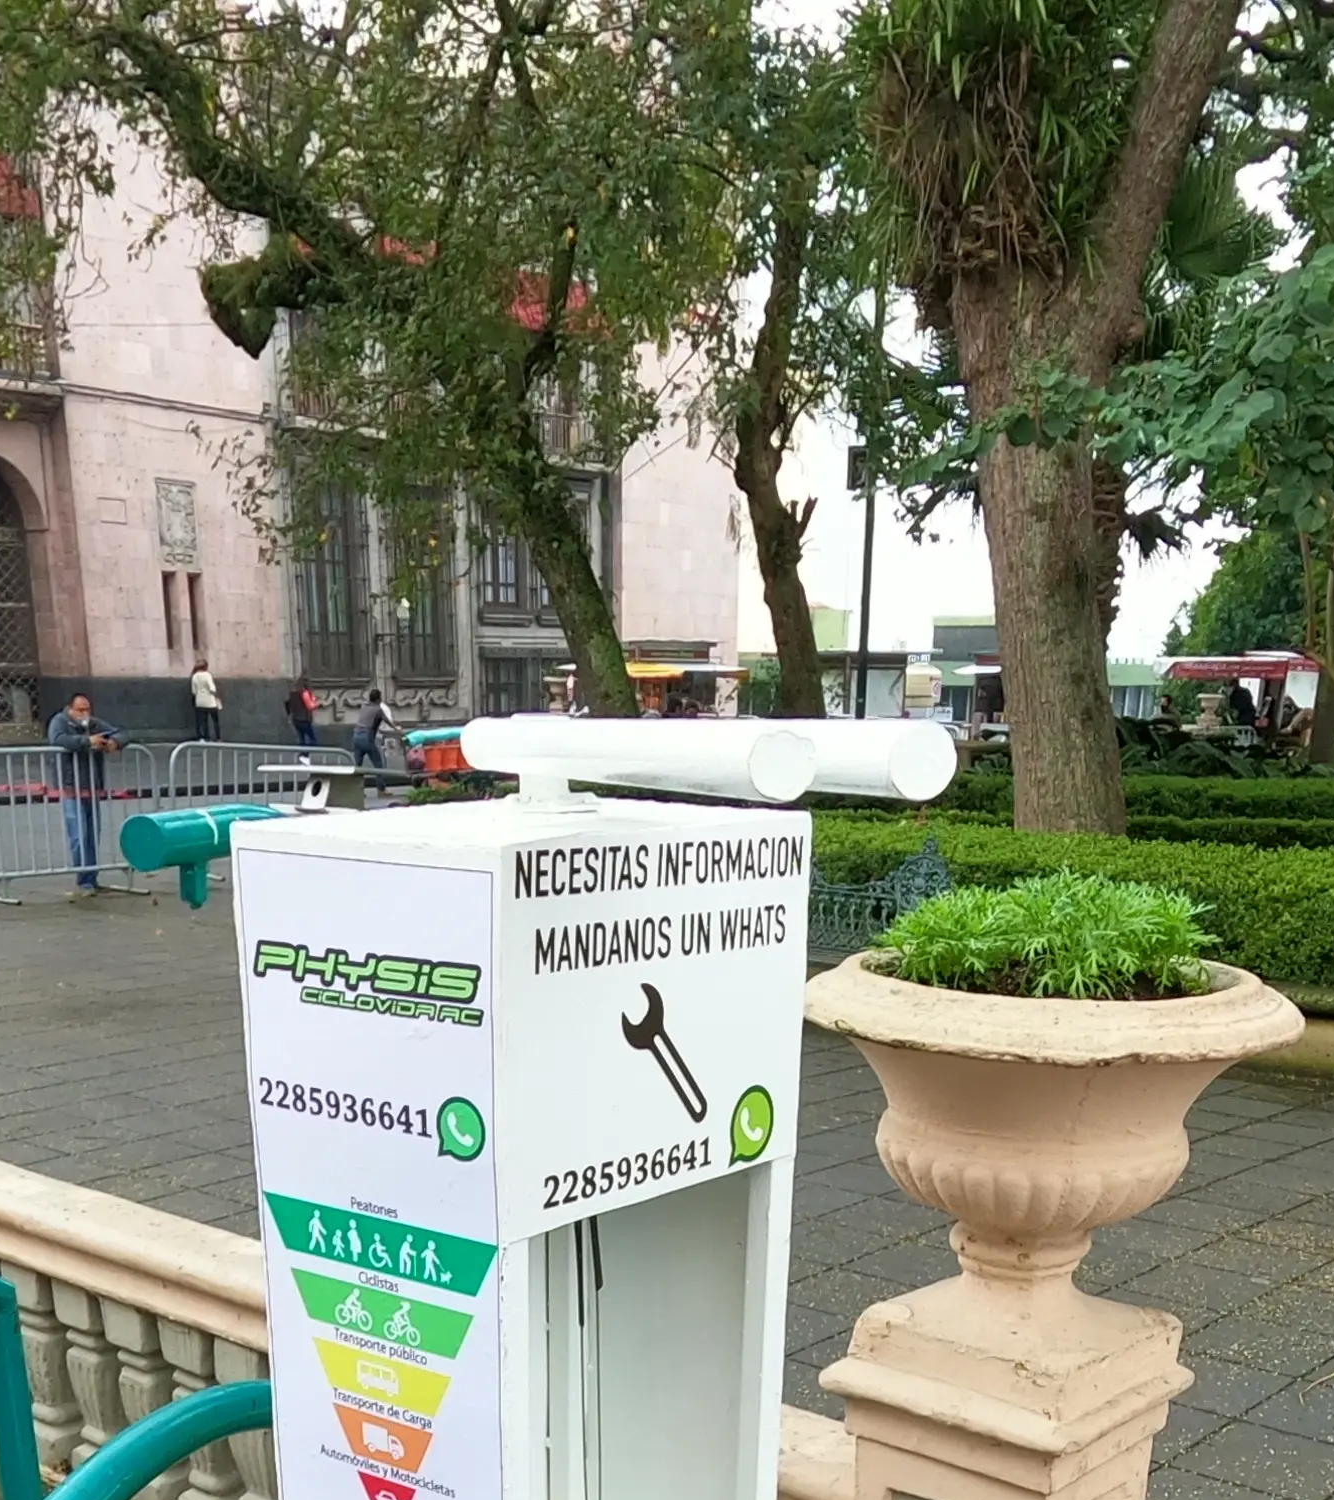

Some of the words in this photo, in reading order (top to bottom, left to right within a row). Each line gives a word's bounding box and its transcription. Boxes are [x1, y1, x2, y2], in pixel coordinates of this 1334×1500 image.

[514, 844, 650, 899] NECESITAS
[657, 835, 804, 887] INFORMACION
[534, 915, 672, 975] MANDANOS
[681, 912, 712, 957] UN
[720, 904, 786, 951] WHATS
[437, 1004, 484, 1027] AC
[259, 1077, 433, 1138] 2285936641
[543, 1136, 712, 1210] 2285936641
[350, 1196, 398, 1219] Peatones
[358, 1271, 399, 1293] Ciclistas
[335, 1327, 386, 1353] Transporte
[389, 1345, 428, 1366] público
[333, 1387, 385, 1413] Transporte
[387, 1405, 400, 1419] de
[403, 1410, 432, 1430] Carga
[320, 1444, 381, 1473] Automóviles
[381, 1467, 388, 1478] y
[391, 1467, 455, 1498] Motocicletas
